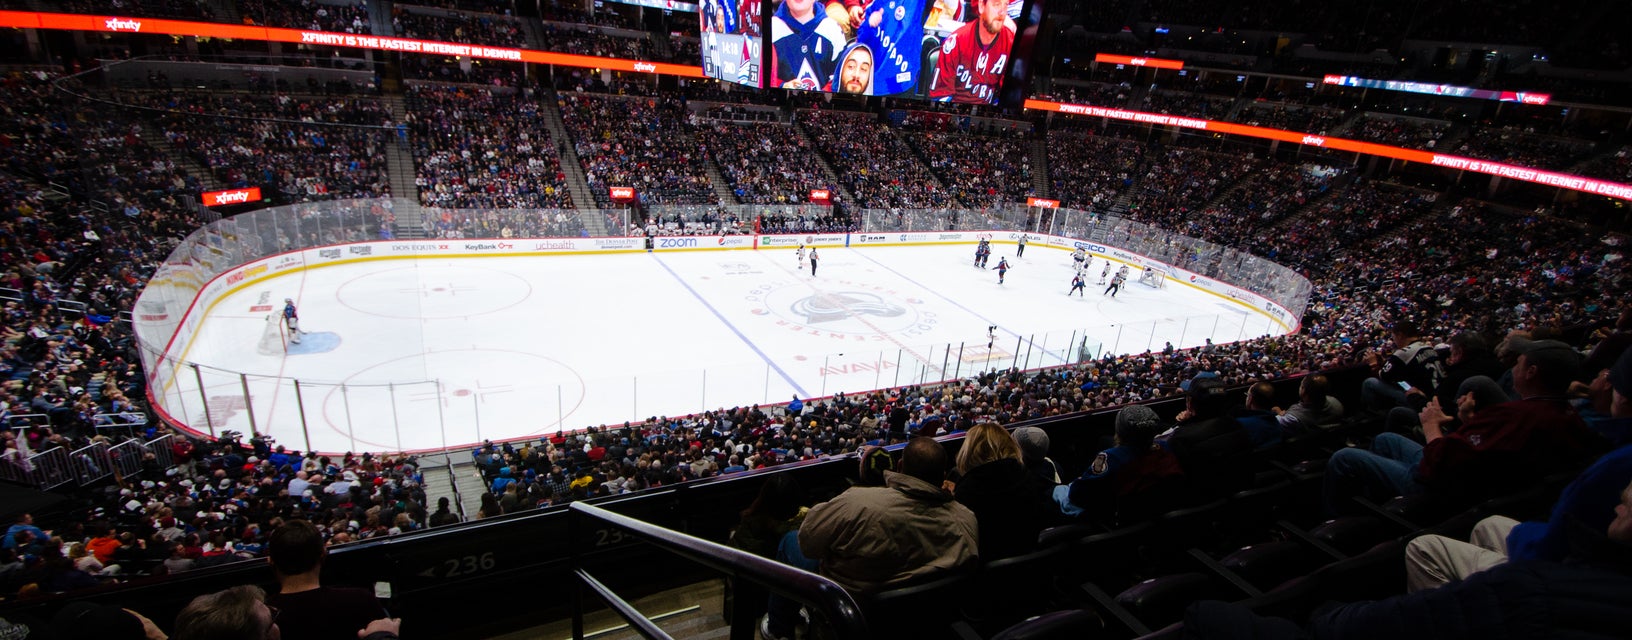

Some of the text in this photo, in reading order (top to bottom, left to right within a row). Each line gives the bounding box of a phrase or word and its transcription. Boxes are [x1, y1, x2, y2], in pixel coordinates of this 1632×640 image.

[105, 18, 141, 32] xfinity
[302, 32, 522, 60] XFINITY IS THE FASTEST INTERNET IN DENVER
[752, 42, 759, 58] 0
[634, 62, 656, 72] xfinity
[1060, 104, 1207, 129] XFINITY IS THE FASTEST INTERNET IN DENVER
[1302, 134, 1324, 146] xfinity
[1432, 155, 1468, 169] XFINITY
[1469, 161, 1479, 171] IS
[1481, 163, 1498, 174] THE
[1499, 165, 1536, 181] FASTEST
[1536, 173, 1585, 189] INTERNET
[1585, 180, 1597, 192] IN
[215, 191, 249, 205] xfinity
[1034, 199, 1053, 208] xfinity
[412, 244, 437, 252] EQUIS
[465, 243, 497, 251] KeyBank
[535, 240, 575, 250] uchealth
[661, 238, 697, 248] zoom
[1074, 241, 1106, 254] GEICO
[445, 552, 496, 577] 236
